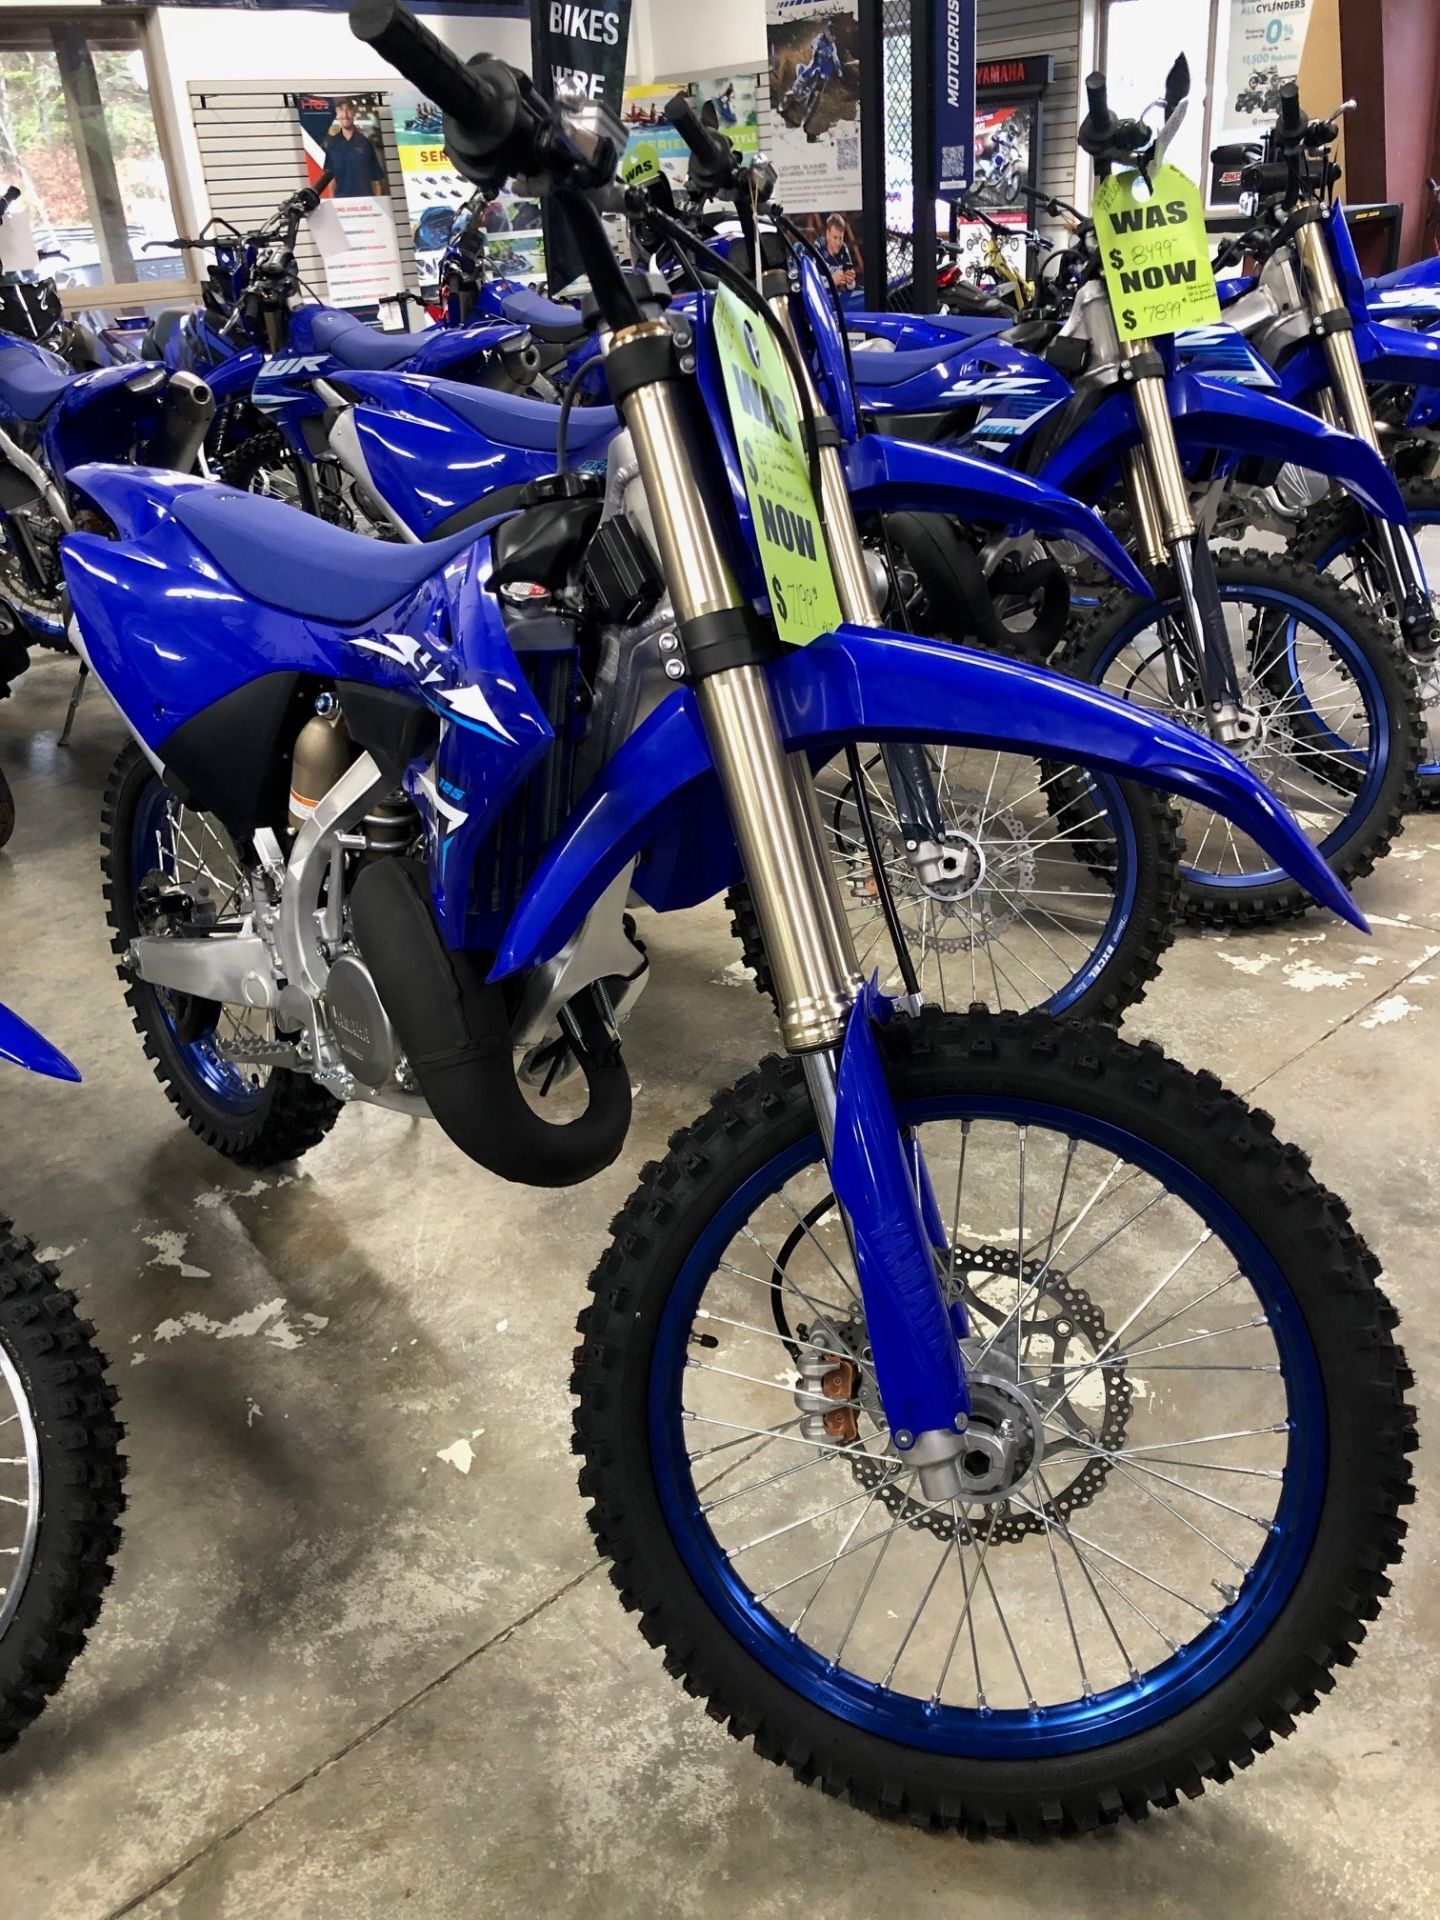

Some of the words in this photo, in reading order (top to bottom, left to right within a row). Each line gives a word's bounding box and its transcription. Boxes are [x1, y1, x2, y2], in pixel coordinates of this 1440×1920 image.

[549, 1, 619, 45] BIKES
[625, 160, 654, 183] WAS
[1109, 200, 1188, 235] WAS
[1109, 248, 1125, 271] $
[1120, 259, 1196, 294] NOW
[1122, 308, 1137, 331] $
[259, 355, 331, 377] WR
[731, 363, 793, 443] WAS
[939, 377, 1050, 397] YZ
[758, 494, 817, 562] NOW
[772, 573, 788, 623] $
[438, 777, 465, 800] 125
[1087, 944, 1115, 978] EXCEL
